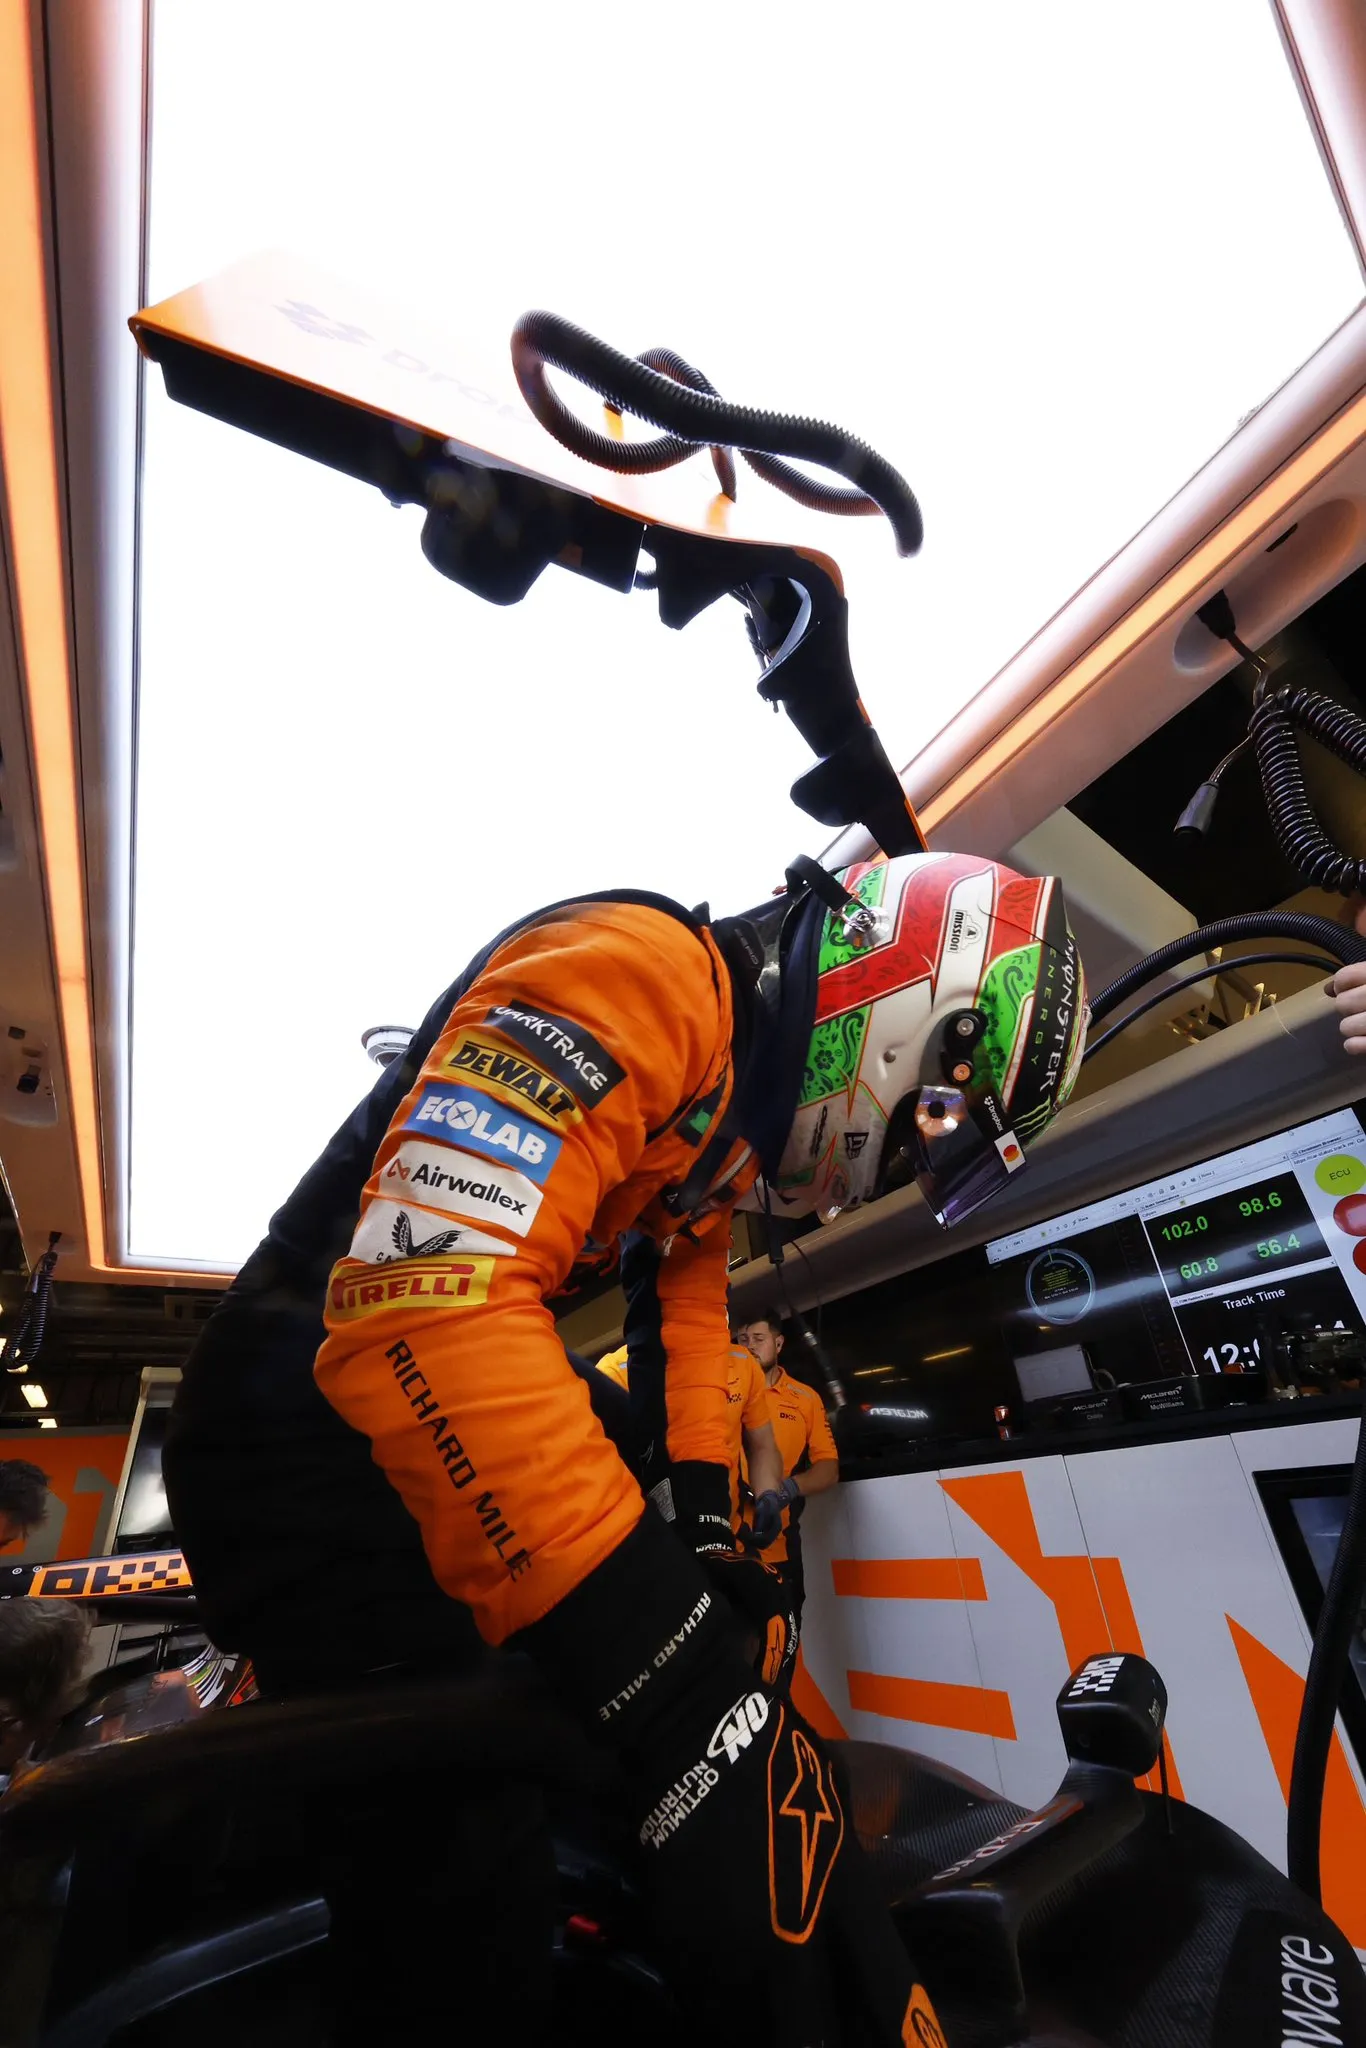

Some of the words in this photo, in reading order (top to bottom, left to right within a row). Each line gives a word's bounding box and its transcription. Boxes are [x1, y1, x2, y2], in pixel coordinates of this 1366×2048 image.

[1031, 947, 1057, 1065] ENERGY
[452, 1044, 577, 1120] DEWALT
[416, 1096, 547, 1165] ECOLAB
[988, 1105, 1004, 1132] Dropbox
[411, 1163, 527, 1217] Airwallex
[1329, 1167, 1351, 1182] ECU
[1161, 1216, 1209, 1242] 102.0
[1238, 1191, 1283, 1217] 98.6
[330, 1263, 477, 1310] PIRELLI
[1180, 1257, 1219, 1280] 60.8
[1256, 1233, 1301, 1259] 56.4
[1223, 1295, 1255, 1310] Track
[1256, 1288, 1286, 1302] Time
[384, 1339, 477, 1490] RICHARD
[653, 1591, 712, 1670] RICHARD
[598, 1670, 651, 1722] MILLE
[640, 1760, 709, 1846] NUTRITION
[651, 1768, 720, 1850] OPTIMUM
[1280, 1934, 1345, 2048] ware
